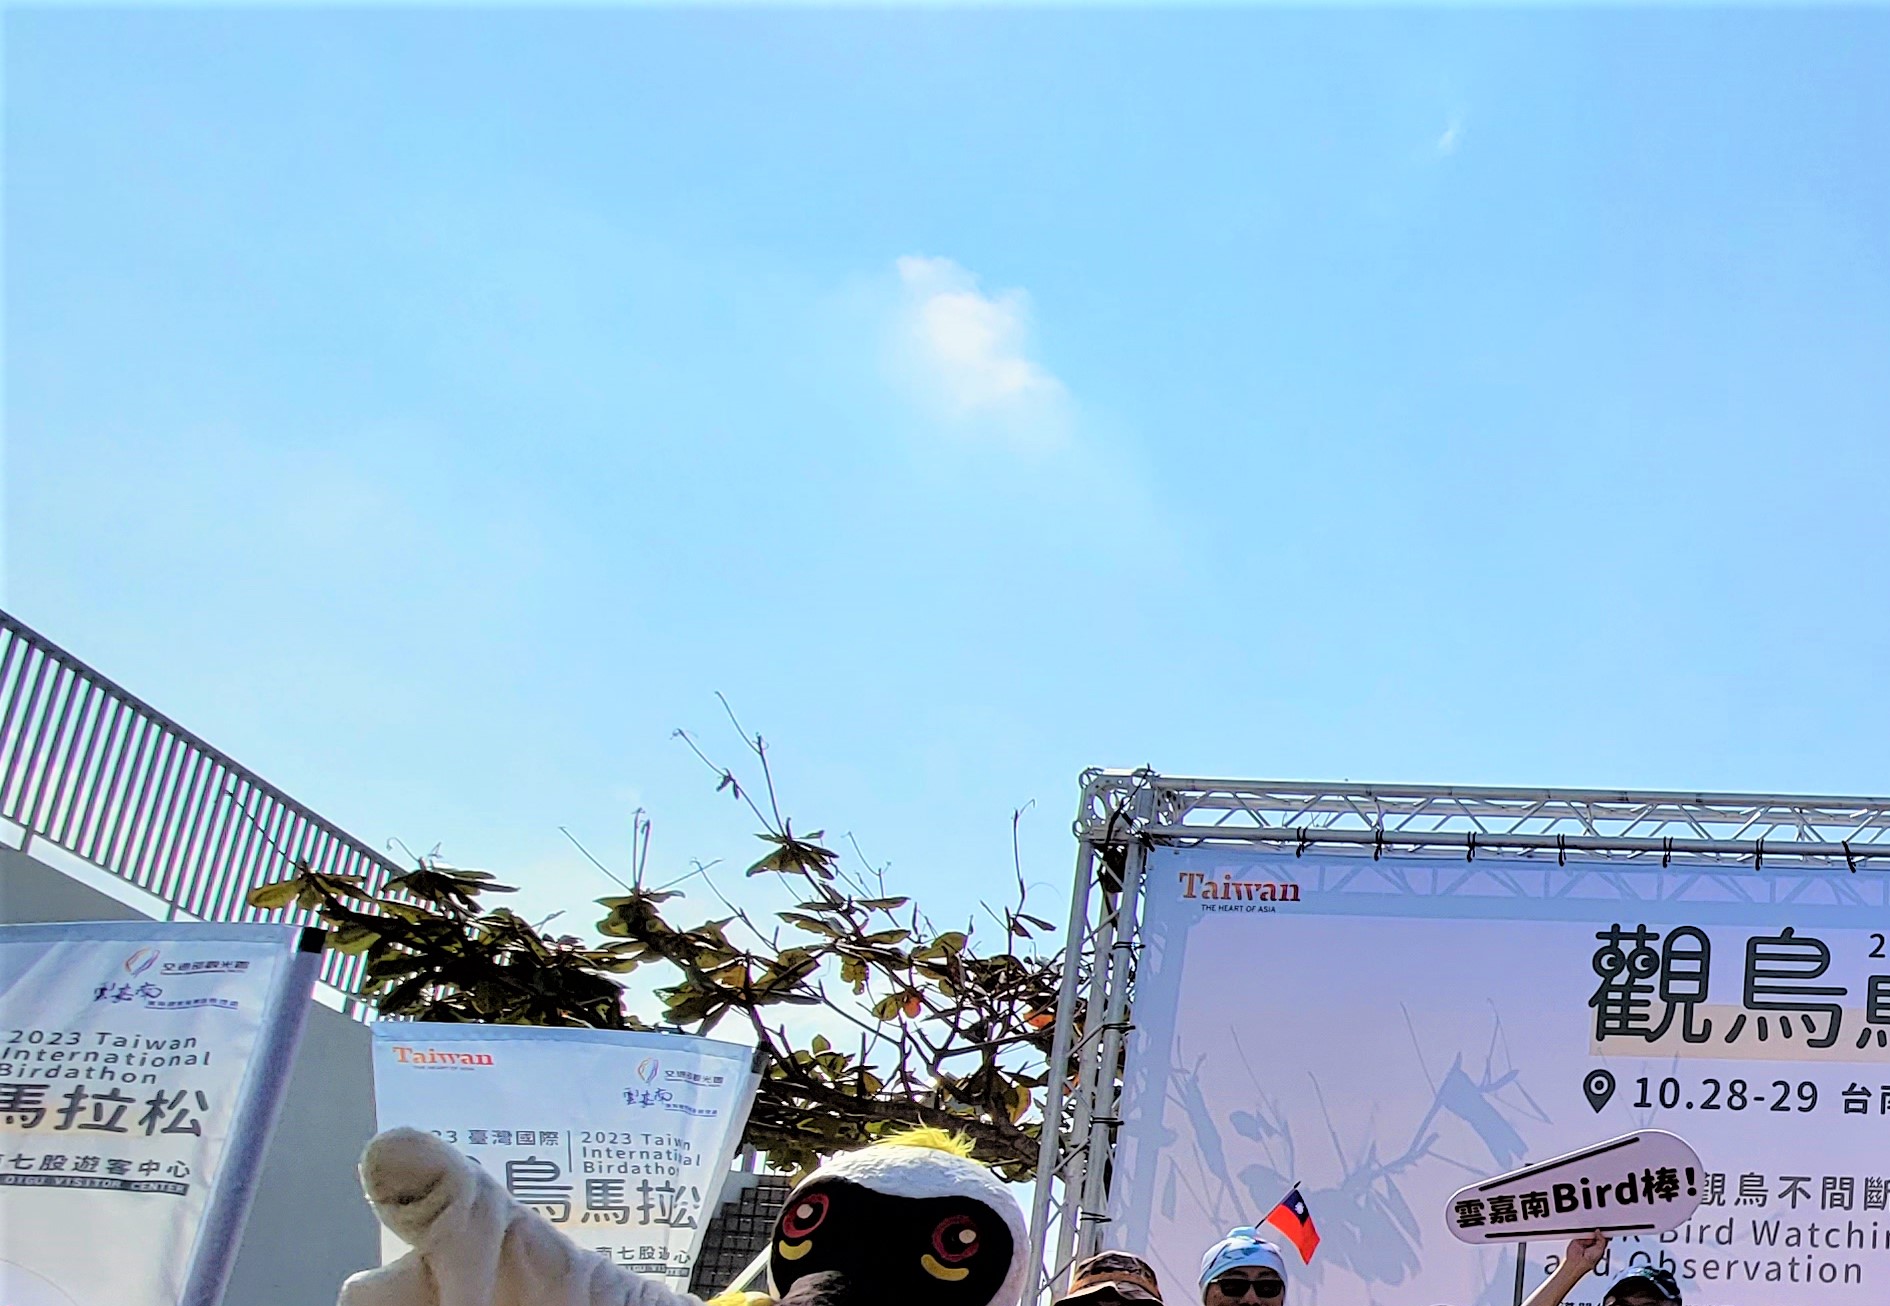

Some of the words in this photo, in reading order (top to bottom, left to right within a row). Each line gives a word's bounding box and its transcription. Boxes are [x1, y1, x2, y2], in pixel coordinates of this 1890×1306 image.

[1179, 872, 1300, 901] Taiwan
[1201, 904, 1216, 912] THE
[8, 1030, 81, 1045] 2023
[96, 1032, 197, 1050] Taiwan
[1, 1047, 210, 1066] International
[392, 1046, 495, 1066] Taiwan
[0, 1063, 157, 1085] Birdathon
[1633, 1078, 1819, 1112] 10.28-29
[0, 1083, 209, 1137] 馬拉松
[581, 1131, 632, 1145] 2023
[641, 1133, 691, 1151] Taiwn
[0, 1154, 191, 1179] 七股遊客中心
[1454, 1166, 1698, 1229] 雲嘉南Bird棒!
[1544, 1249, 1611, 1277] ad
